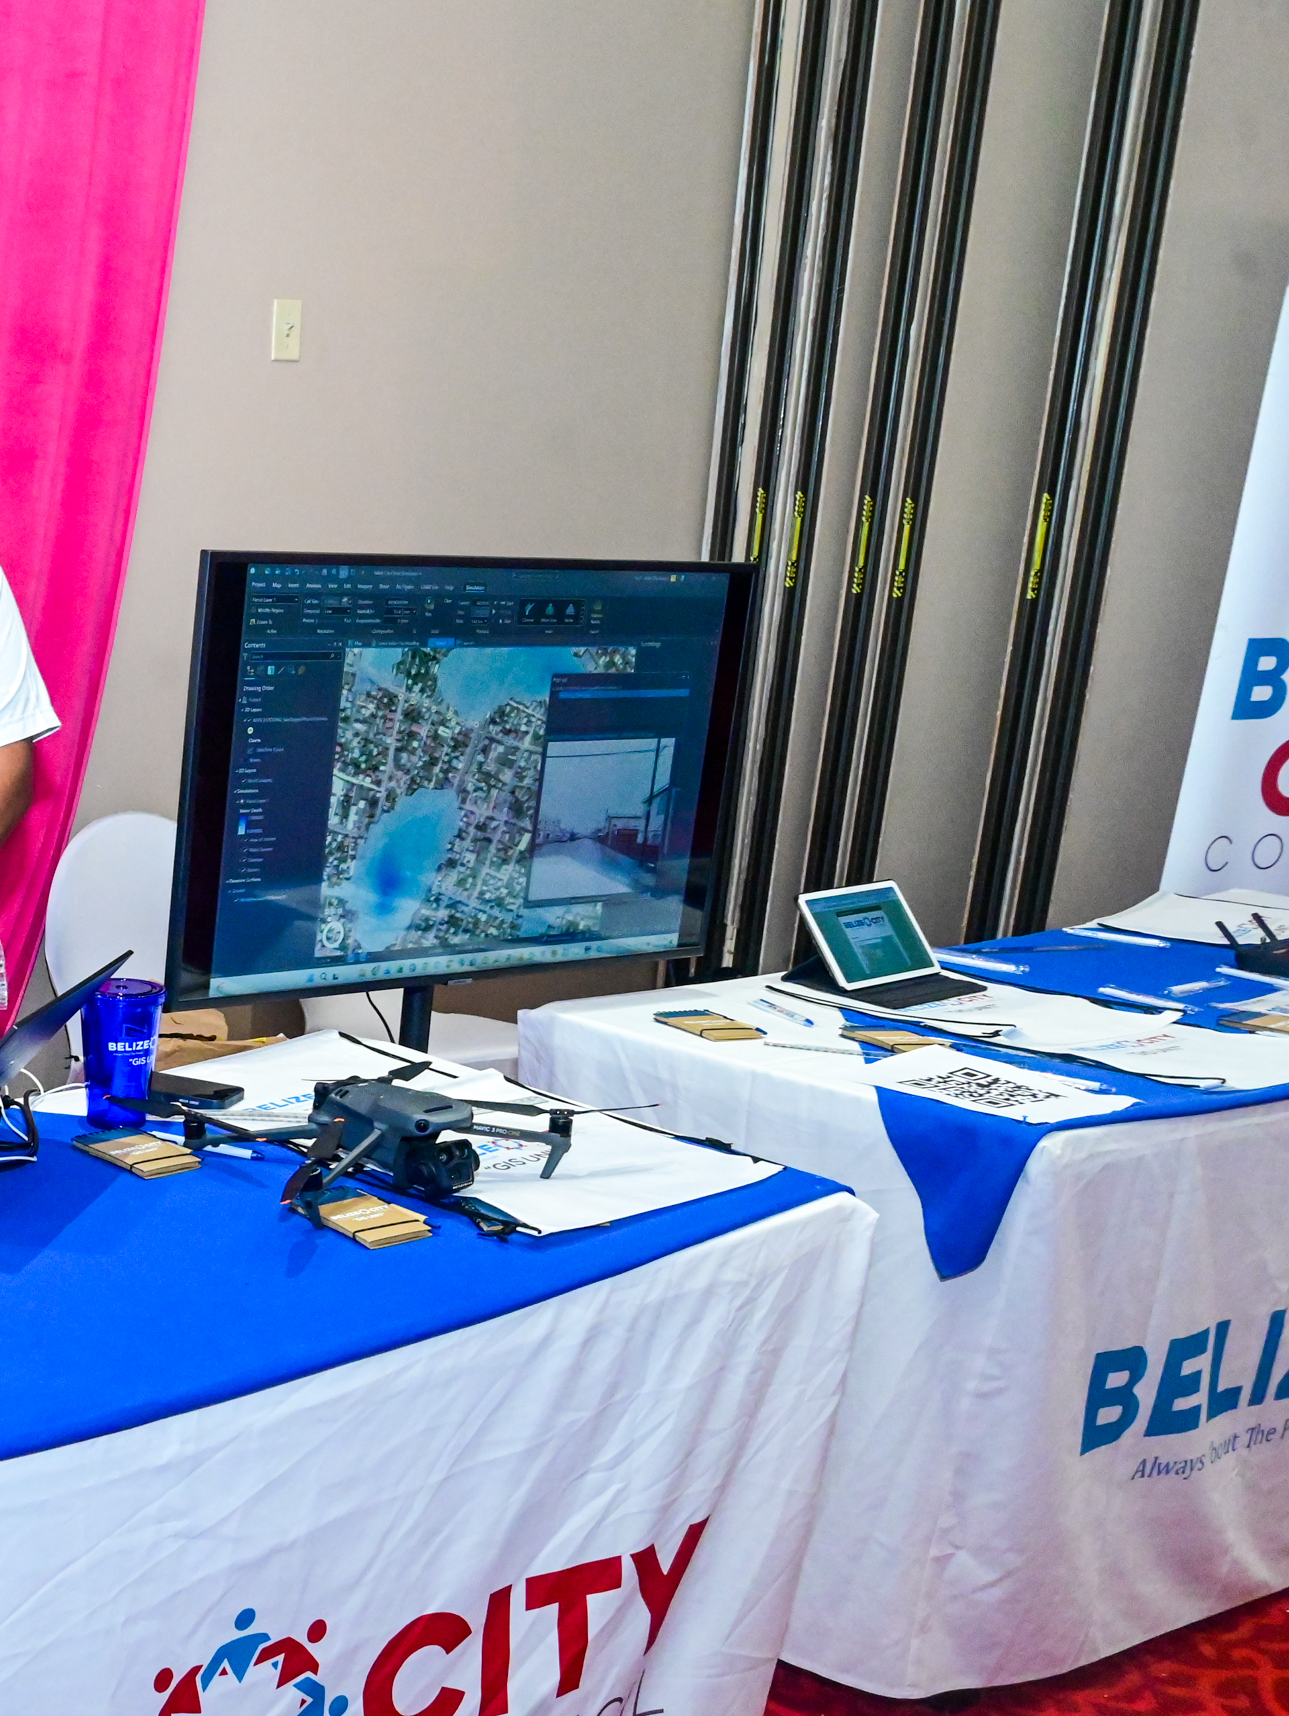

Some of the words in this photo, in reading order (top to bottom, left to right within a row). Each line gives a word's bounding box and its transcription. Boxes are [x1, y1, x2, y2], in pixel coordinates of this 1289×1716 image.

[108, 1040, 150, 1052] BELIZE
[473, 1124, 490, 1133] MAVIC
[521, 1149, 550, 1162] UN
[1130, 1453, 1206, 1481] Always
[1245, 1423, 1277, 1449] The
[363, 1514, 711, 1716] CITY
